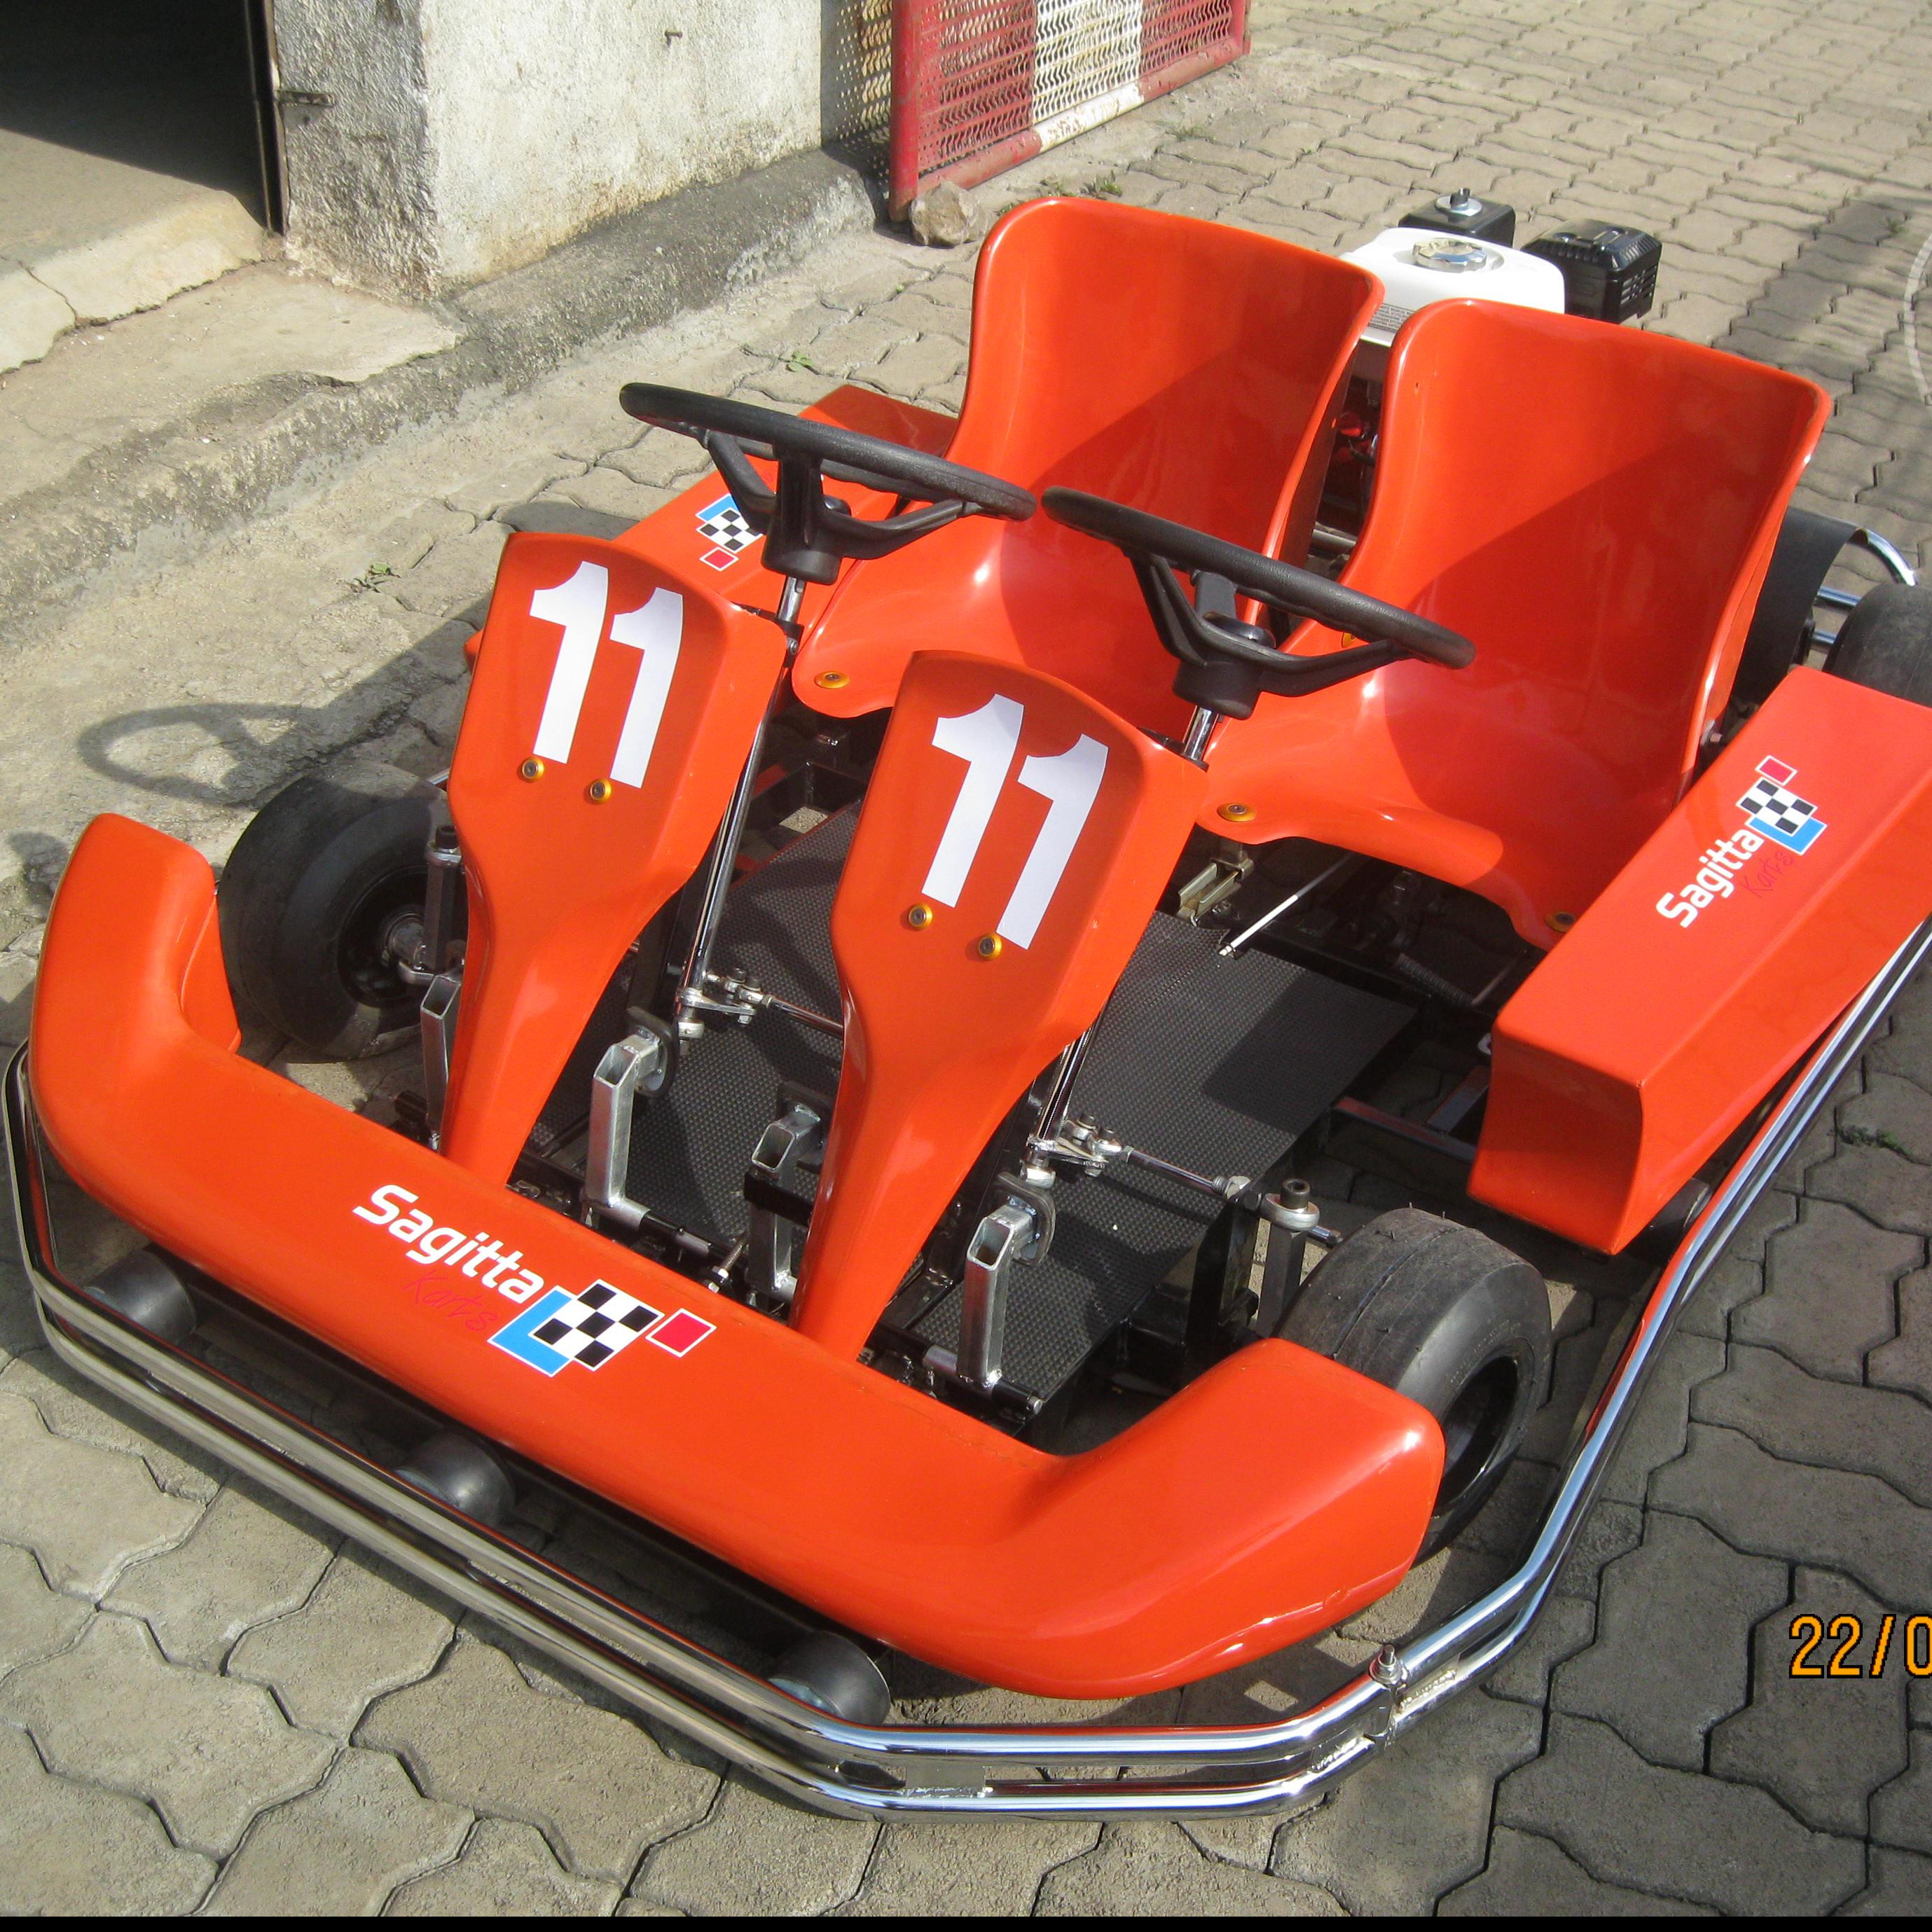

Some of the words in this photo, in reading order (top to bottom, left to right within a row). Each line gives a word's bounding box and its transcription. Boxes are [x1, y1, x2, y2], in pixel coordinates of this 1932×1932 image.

[529, 560, 683, 789] 11
[921, 694, 1109, 950] 11
[1655, 829, 1765, 928] Sagitta
[352, 1184, 545, 1304] Sagitta
[402, 1269, 499, 1332] Karts
